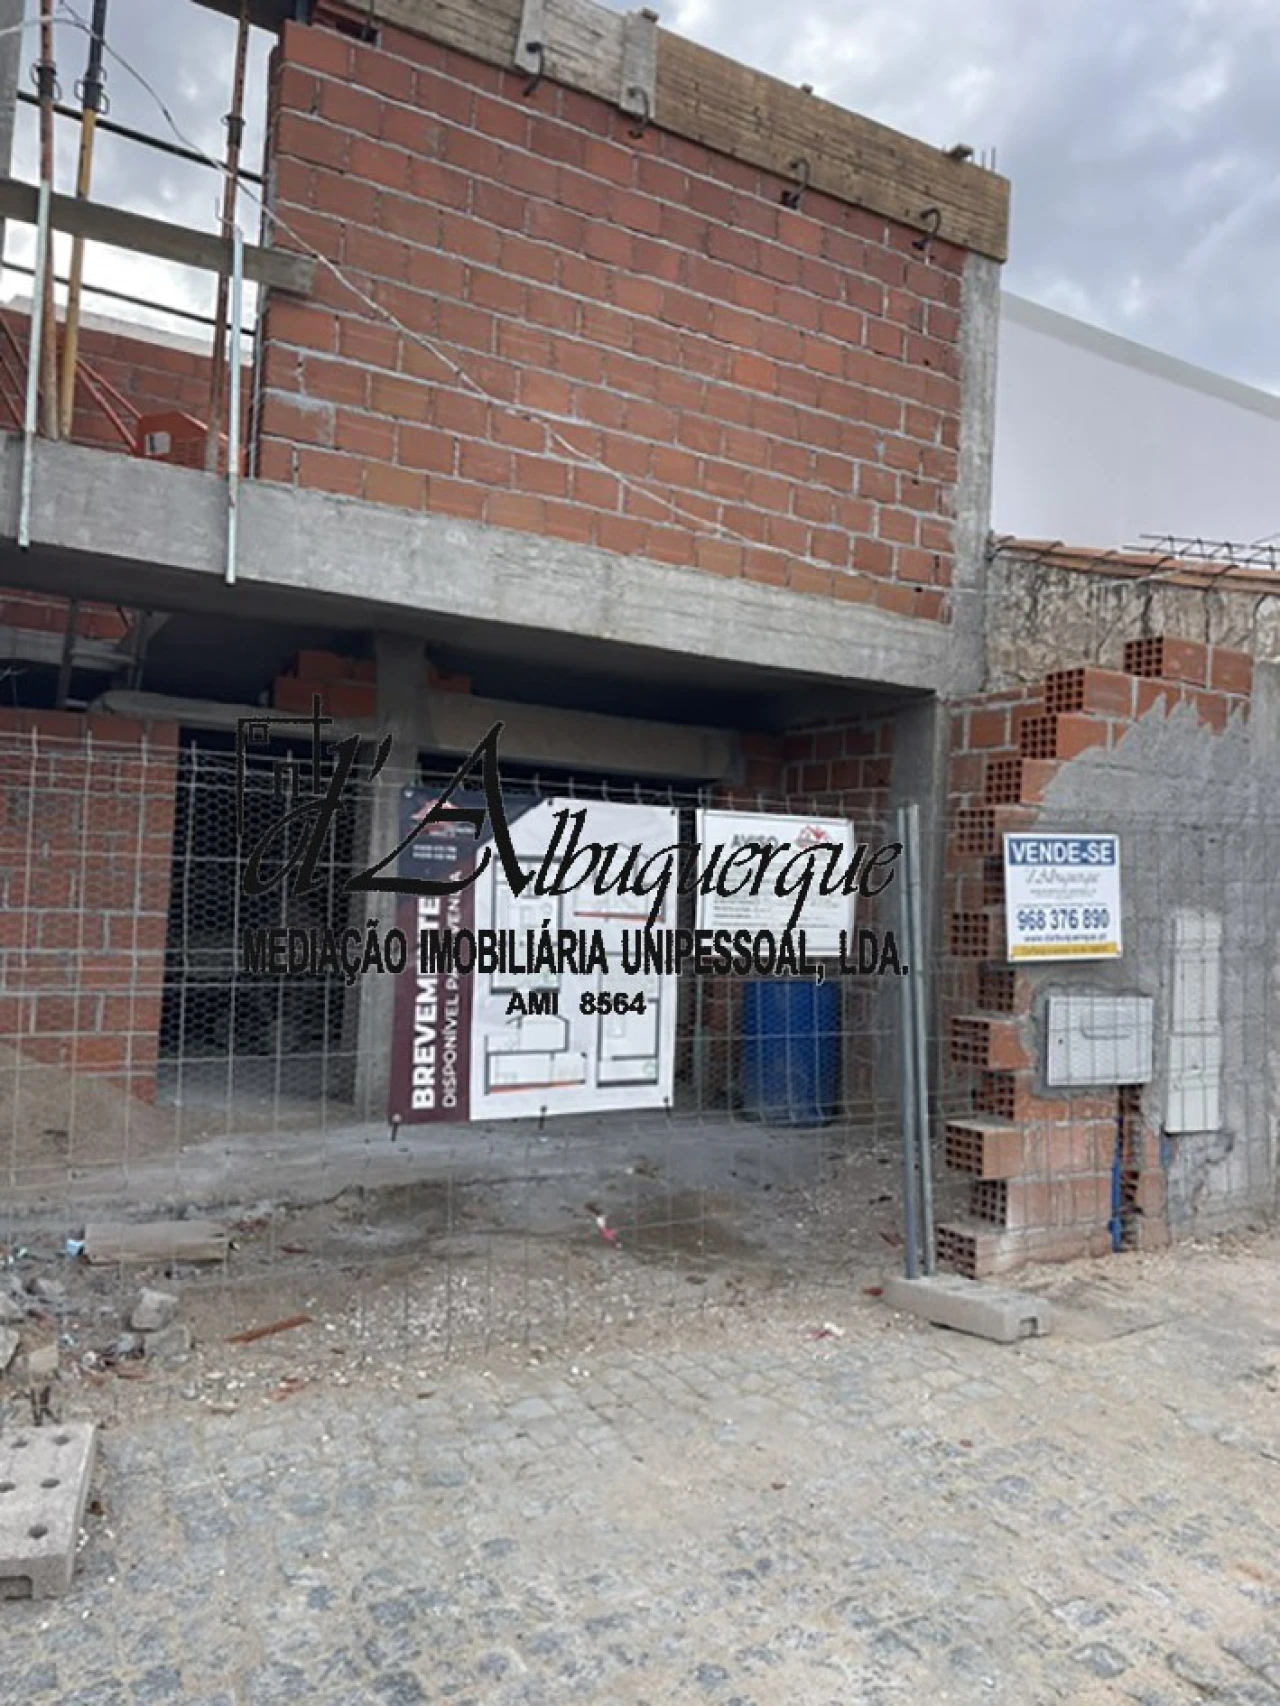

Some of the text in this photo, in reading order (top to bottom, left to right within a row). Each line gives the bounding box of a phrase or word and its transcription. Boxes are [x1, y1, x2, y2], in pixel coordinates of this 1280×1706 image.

[1010, 841, 1112, 863] VENDE-SE
[1018, 907, 1110, 931] 968 376 890
